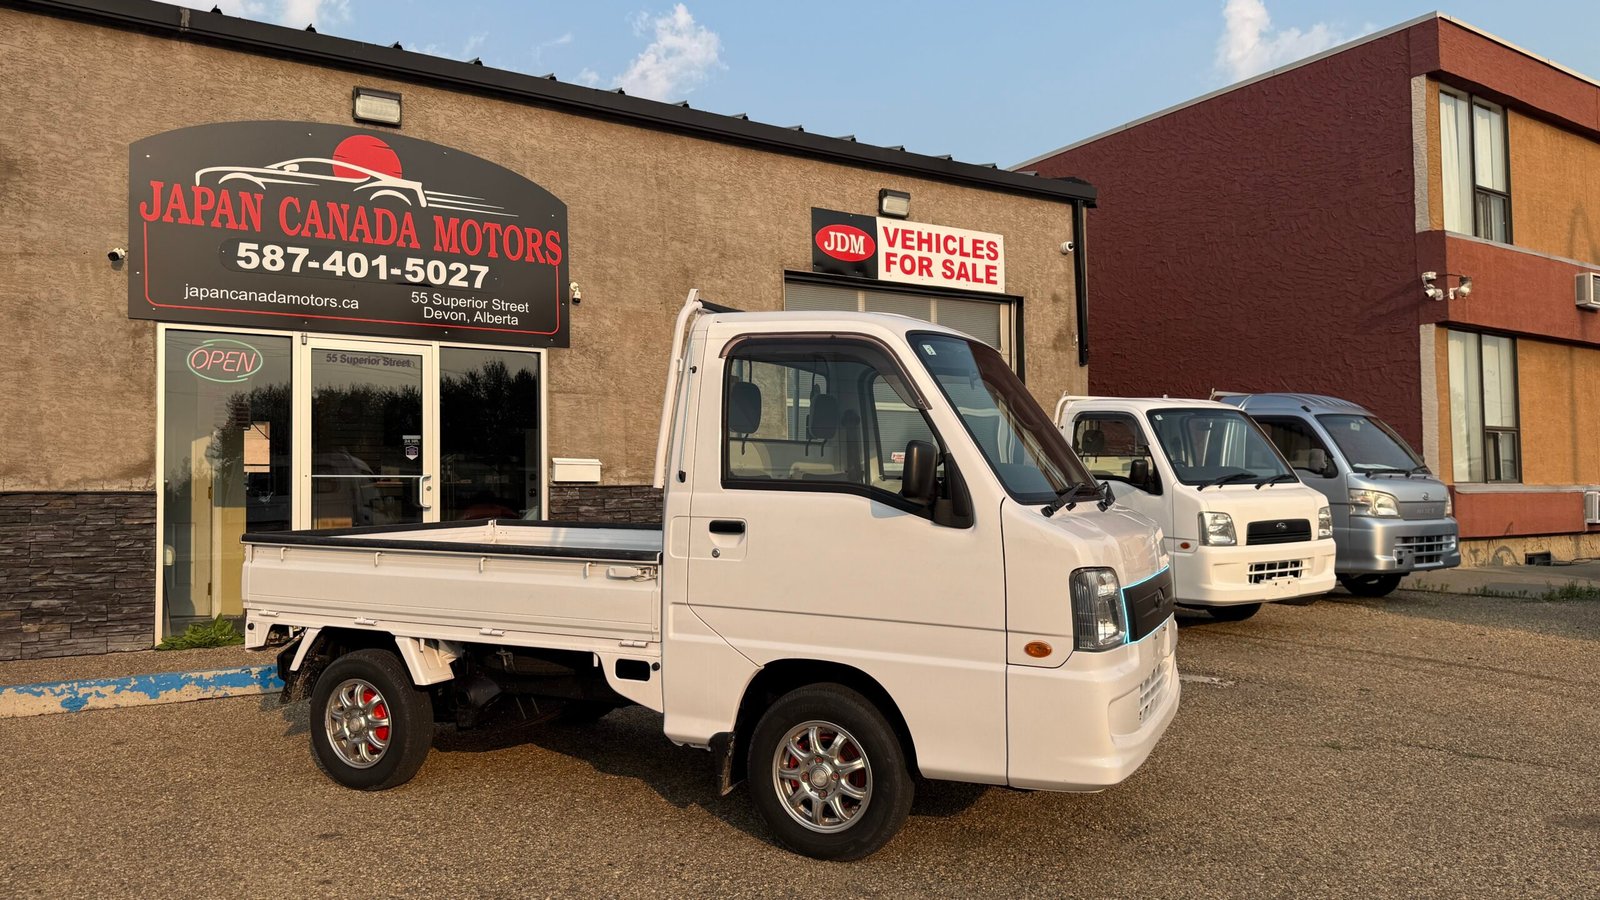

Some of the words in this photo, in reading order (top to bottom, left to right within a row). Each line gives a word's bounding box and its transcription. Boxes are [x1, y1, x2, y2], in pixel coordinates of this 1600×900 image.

[139, 180, 264, 233] JAPAN
[278, 196, 421, 250] CANADA
[433, 214, 563, 267] MOTORS
[823, 230, 866, 255] JDM
[882, 225, 999, 262] VEHICLES
[236, 241, 490, 289] 587-401-5027
[884, 251, 934, 278] FOR
[941, 258, 998, 286] SALE
[183, 283, 360, 310] japancanadamotors.ca
[411, 291, 428, 304] 55
[433, 292, 489, 310] Superior
[491, 298, 530, 313] Street
[423, 306, 470, 324] Devon,
[474, 310, 519, 326] Alberta
[191, 349, 257, 372] OPEN
[326, 353, 338, 363] 55
[340, 354, 381, 366] Superior
[382, 357, 411, 368] Street
